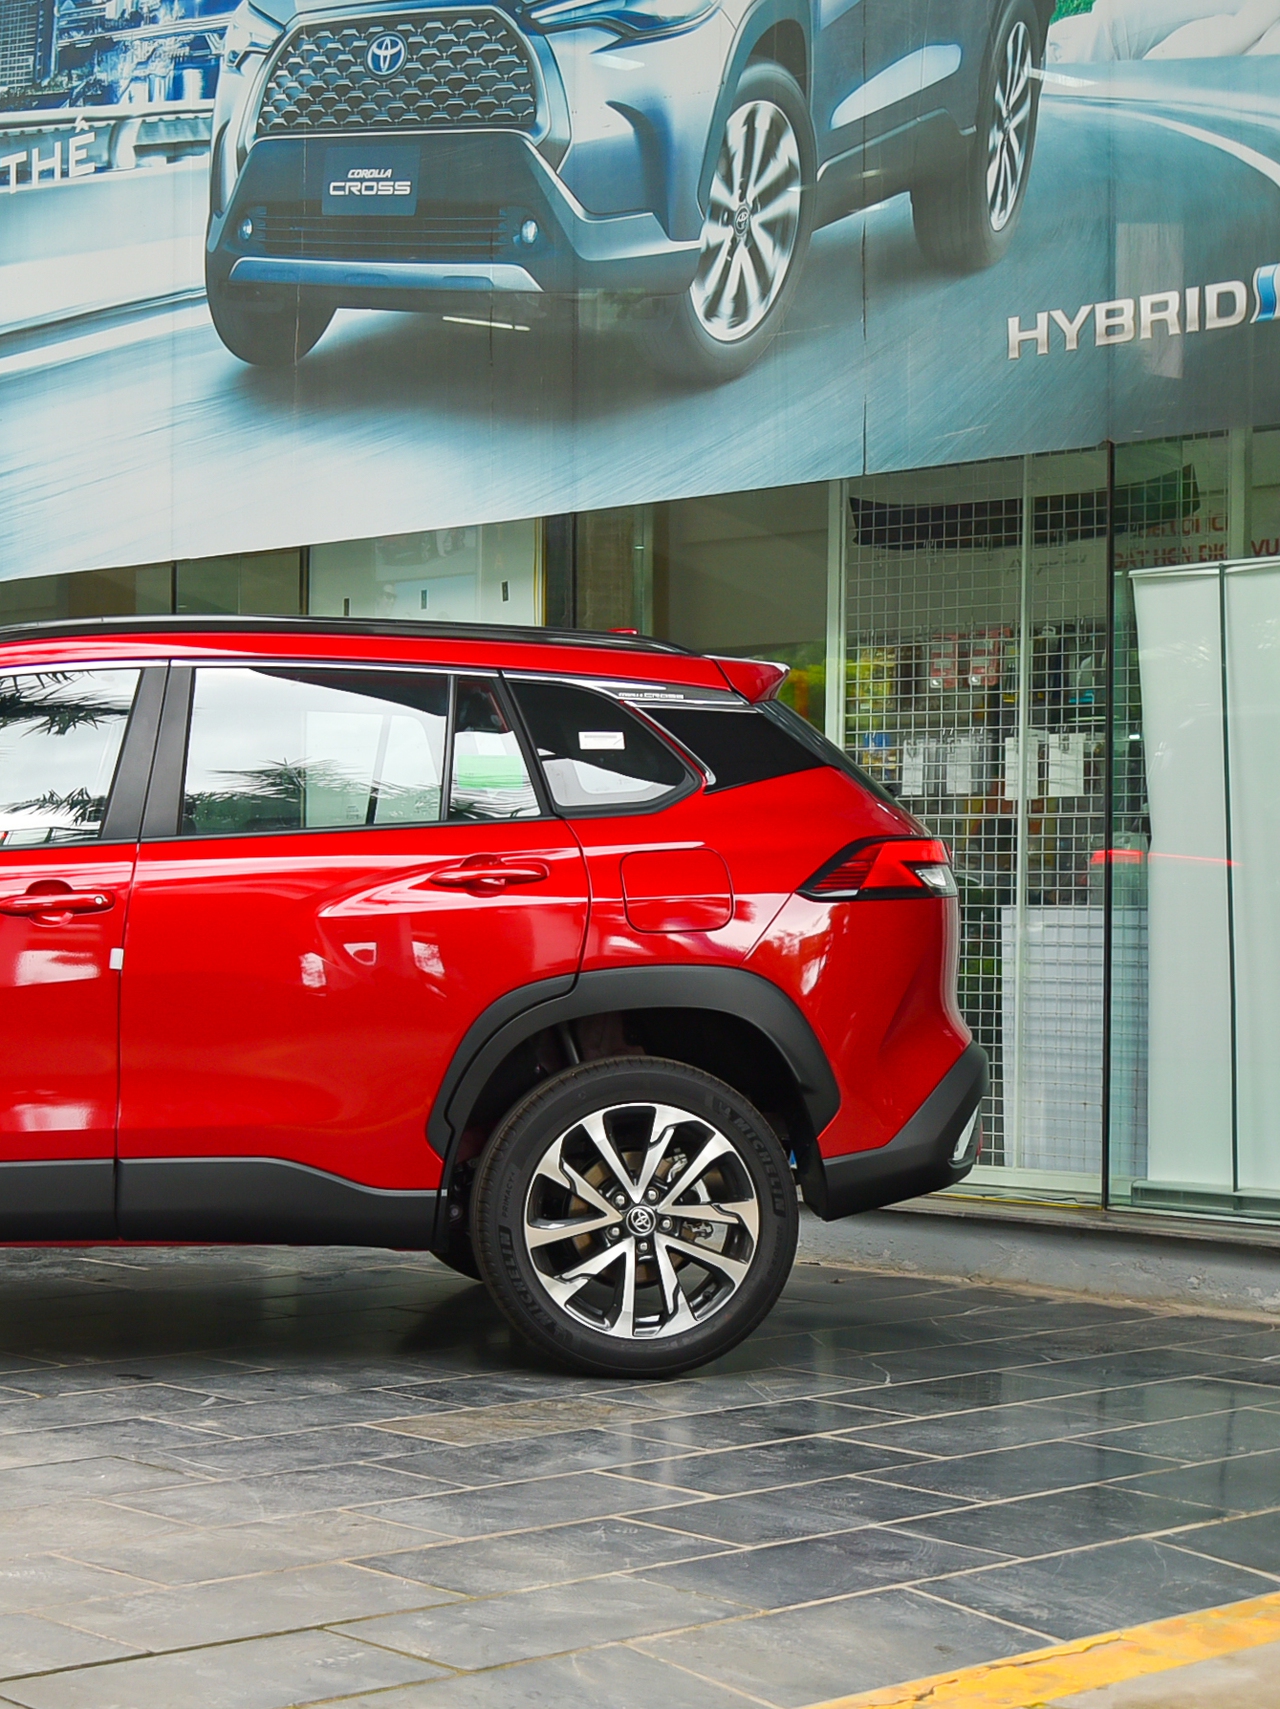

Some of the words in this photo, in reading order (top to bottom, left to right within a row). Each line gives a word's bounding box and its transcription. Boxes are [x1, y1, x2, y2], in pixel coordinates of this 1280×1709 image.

[0, 114, 96, 195] THẾ
[329, 181, 411, 195] CROSS
[347, 168, 392, 179] COROLLA
[1007, 280, 1247, 361] HYBRID
[733, 1116, 786, 1212] MICHELIN
[499, 1230, 553, 1328] MICHELIN
